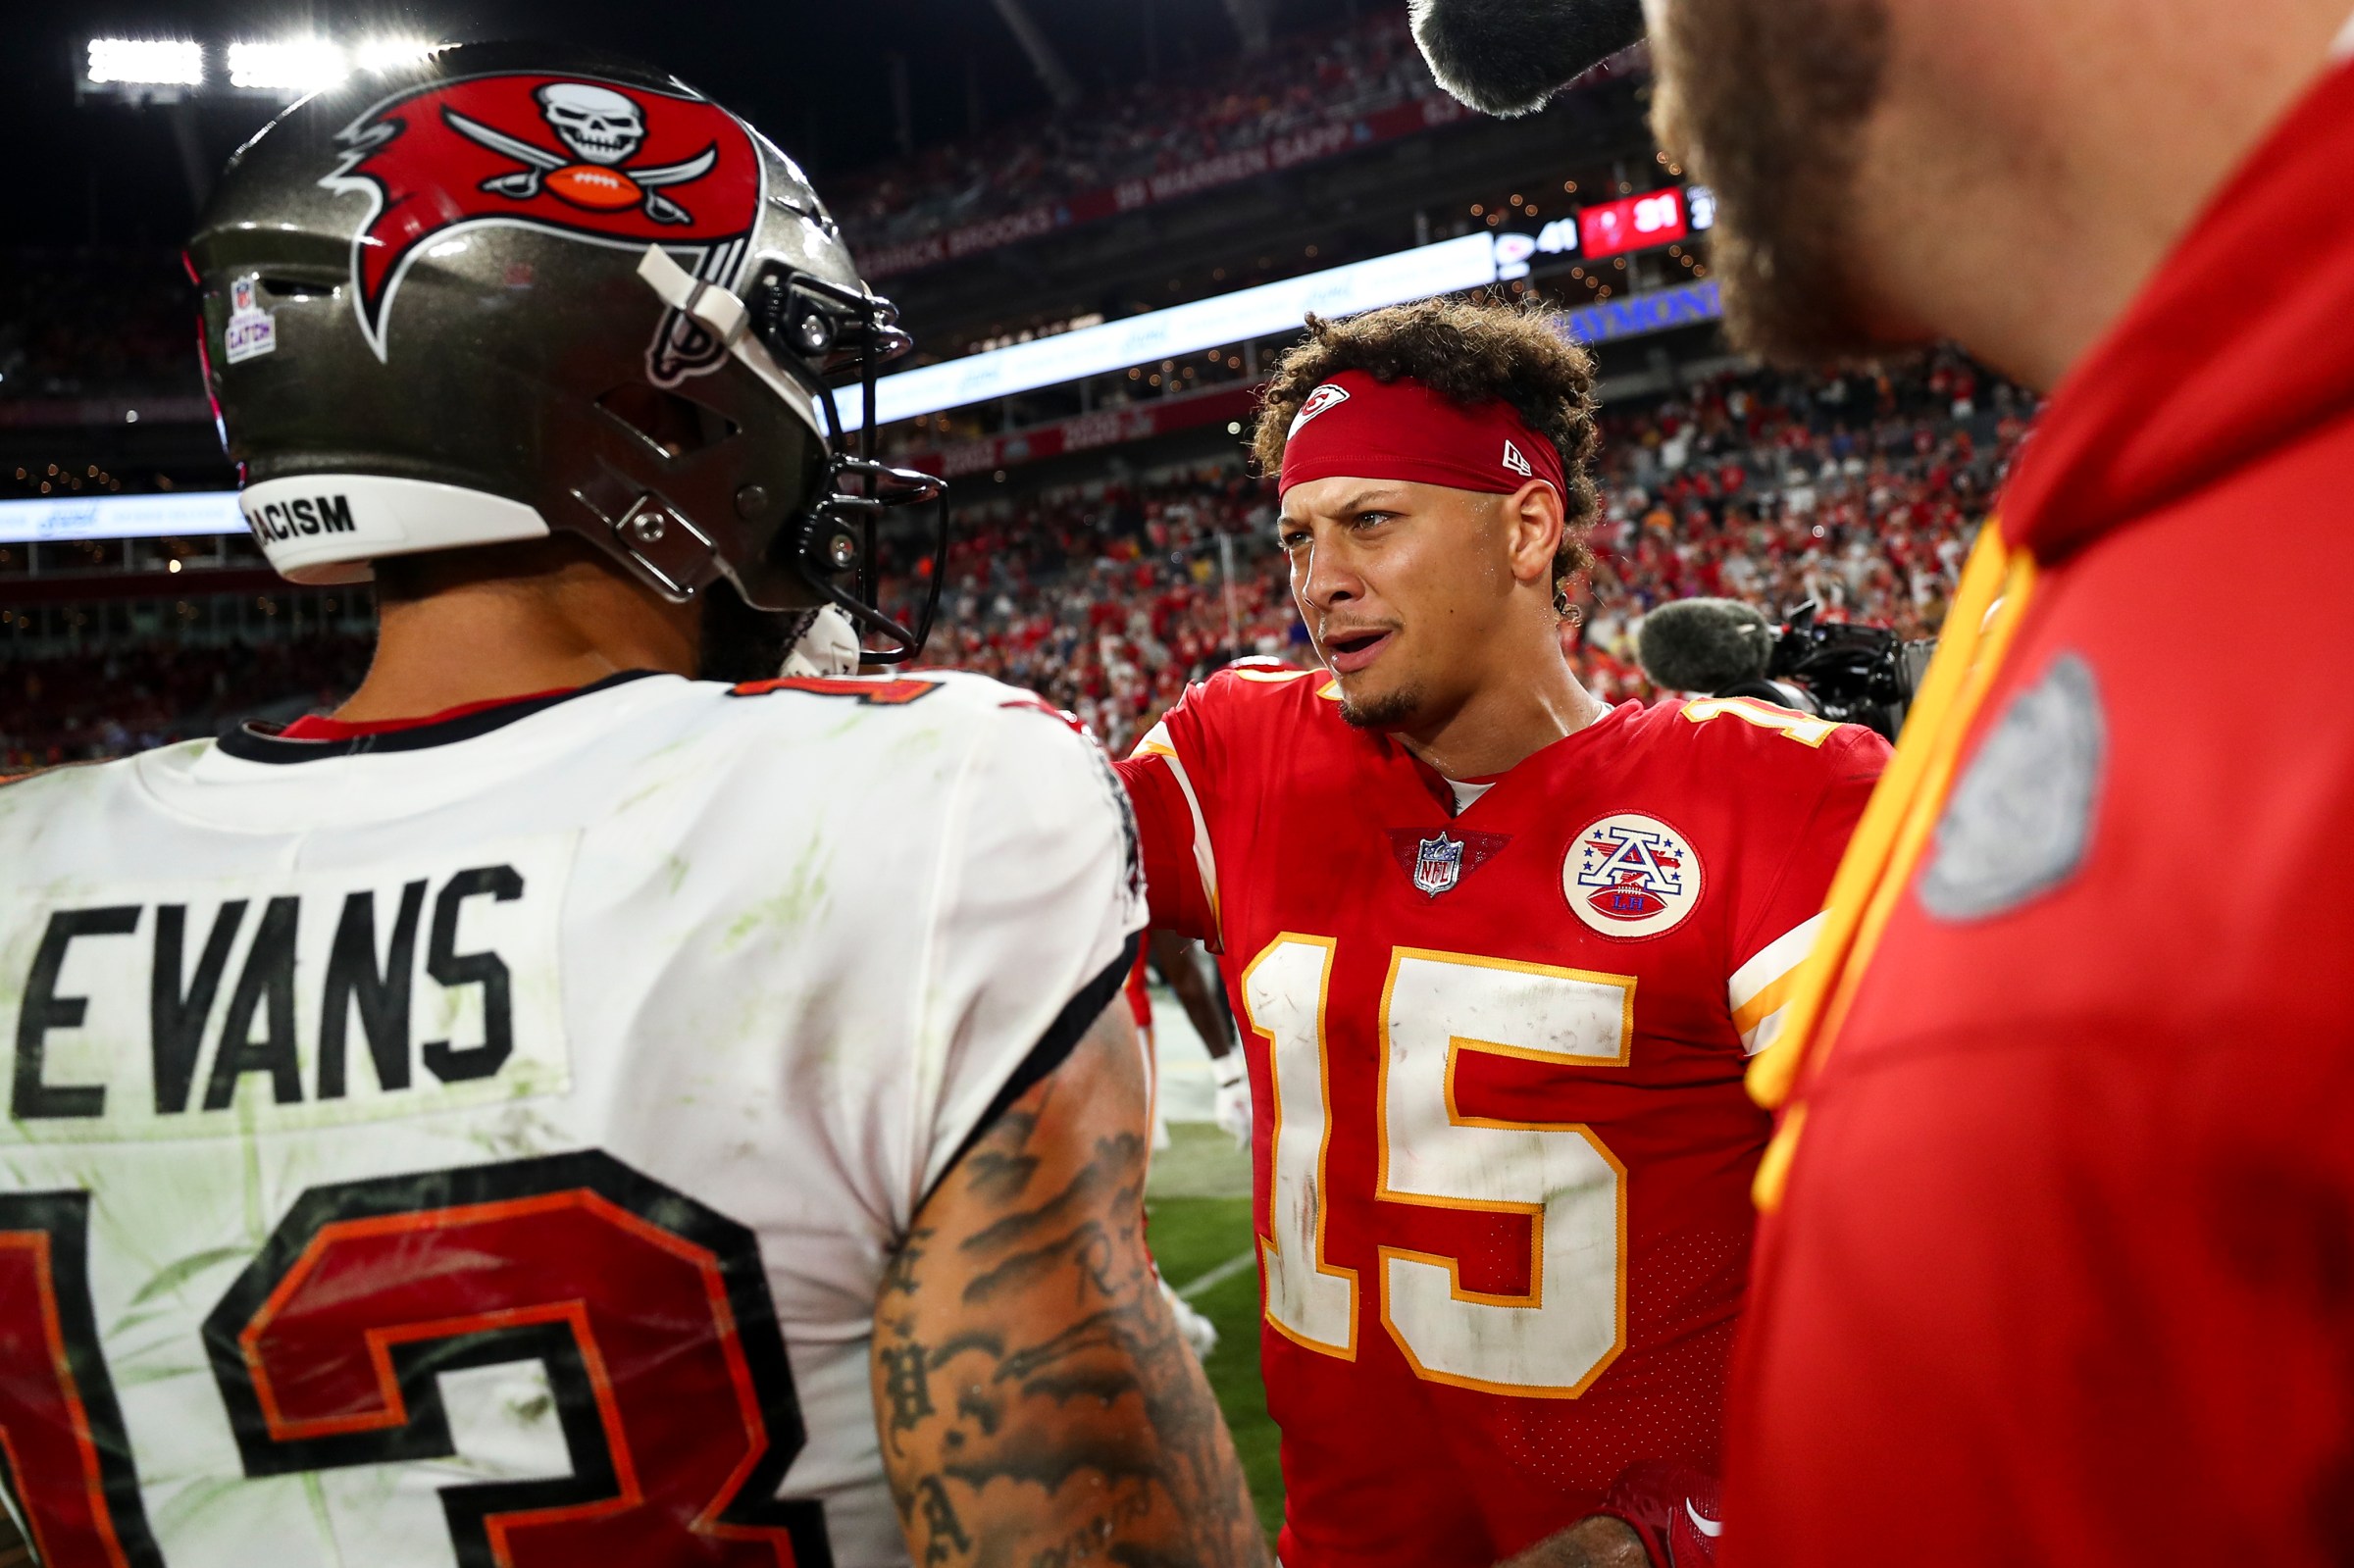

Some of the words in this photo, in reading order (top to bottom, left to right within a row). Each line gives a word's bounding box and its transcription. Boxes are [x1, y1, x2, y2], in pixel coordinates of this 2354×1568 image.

[1148, 147, 1267, 202] WARREN
[1270, 121, 1349, 169] SAPP
[947, 206, 1054, 258] BROOKS
[1536, 217, 1578, 254] 41
[1633, 194, 1678, 232] 31
[1420, 861, 1451, 885] NFL
[1613, 894, 1644, 911] LH
[12, 864, 525, 1118] EVANS
[1241, 931, 1638, 1399] 15
[0, 1148, 836, 1568] 13
